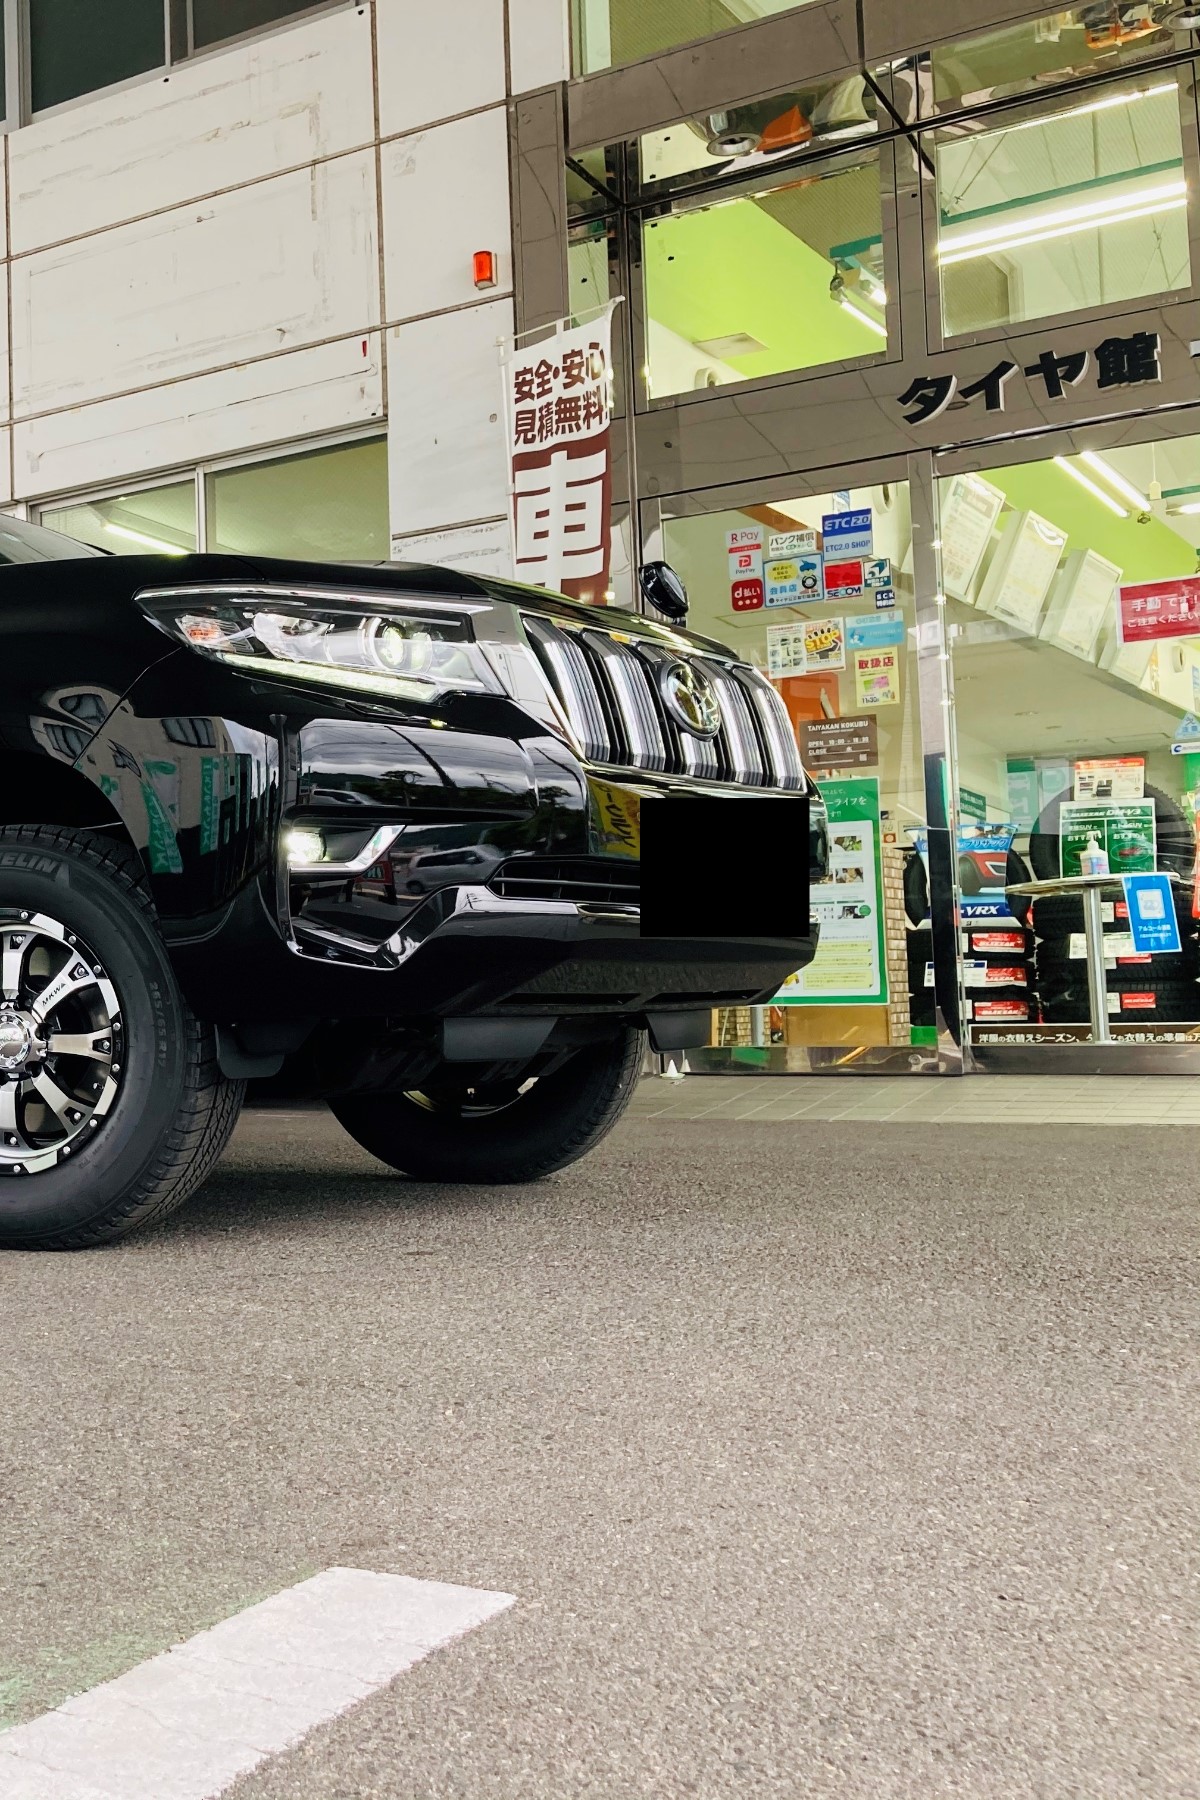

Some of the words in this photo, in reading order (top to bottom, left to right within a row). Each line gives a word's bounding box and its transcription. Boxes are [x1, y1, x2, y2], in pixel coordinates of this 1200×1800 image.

[896, 331, 1162, 427] タイヤ館
[823, 516, 851, 531] ETC
[852, 515, 871, 527] 2.0
[740, 530, 759, 542] Pay
[825, 542, 850, 552] ETC2.0
[851, 539, 871, 549] SHOP
[735, 567, 756, 575] PayPay
[827, 586, 862, 598] SECOM
[804, 629, 841, 651] STOP
[858, 656, 895, 670] 取扱店
[807, 723, 840, 732] TAIYAKAN
[840, 720, 869, 729] KOKUBU
[808, 740, 824, 748] OPEN
